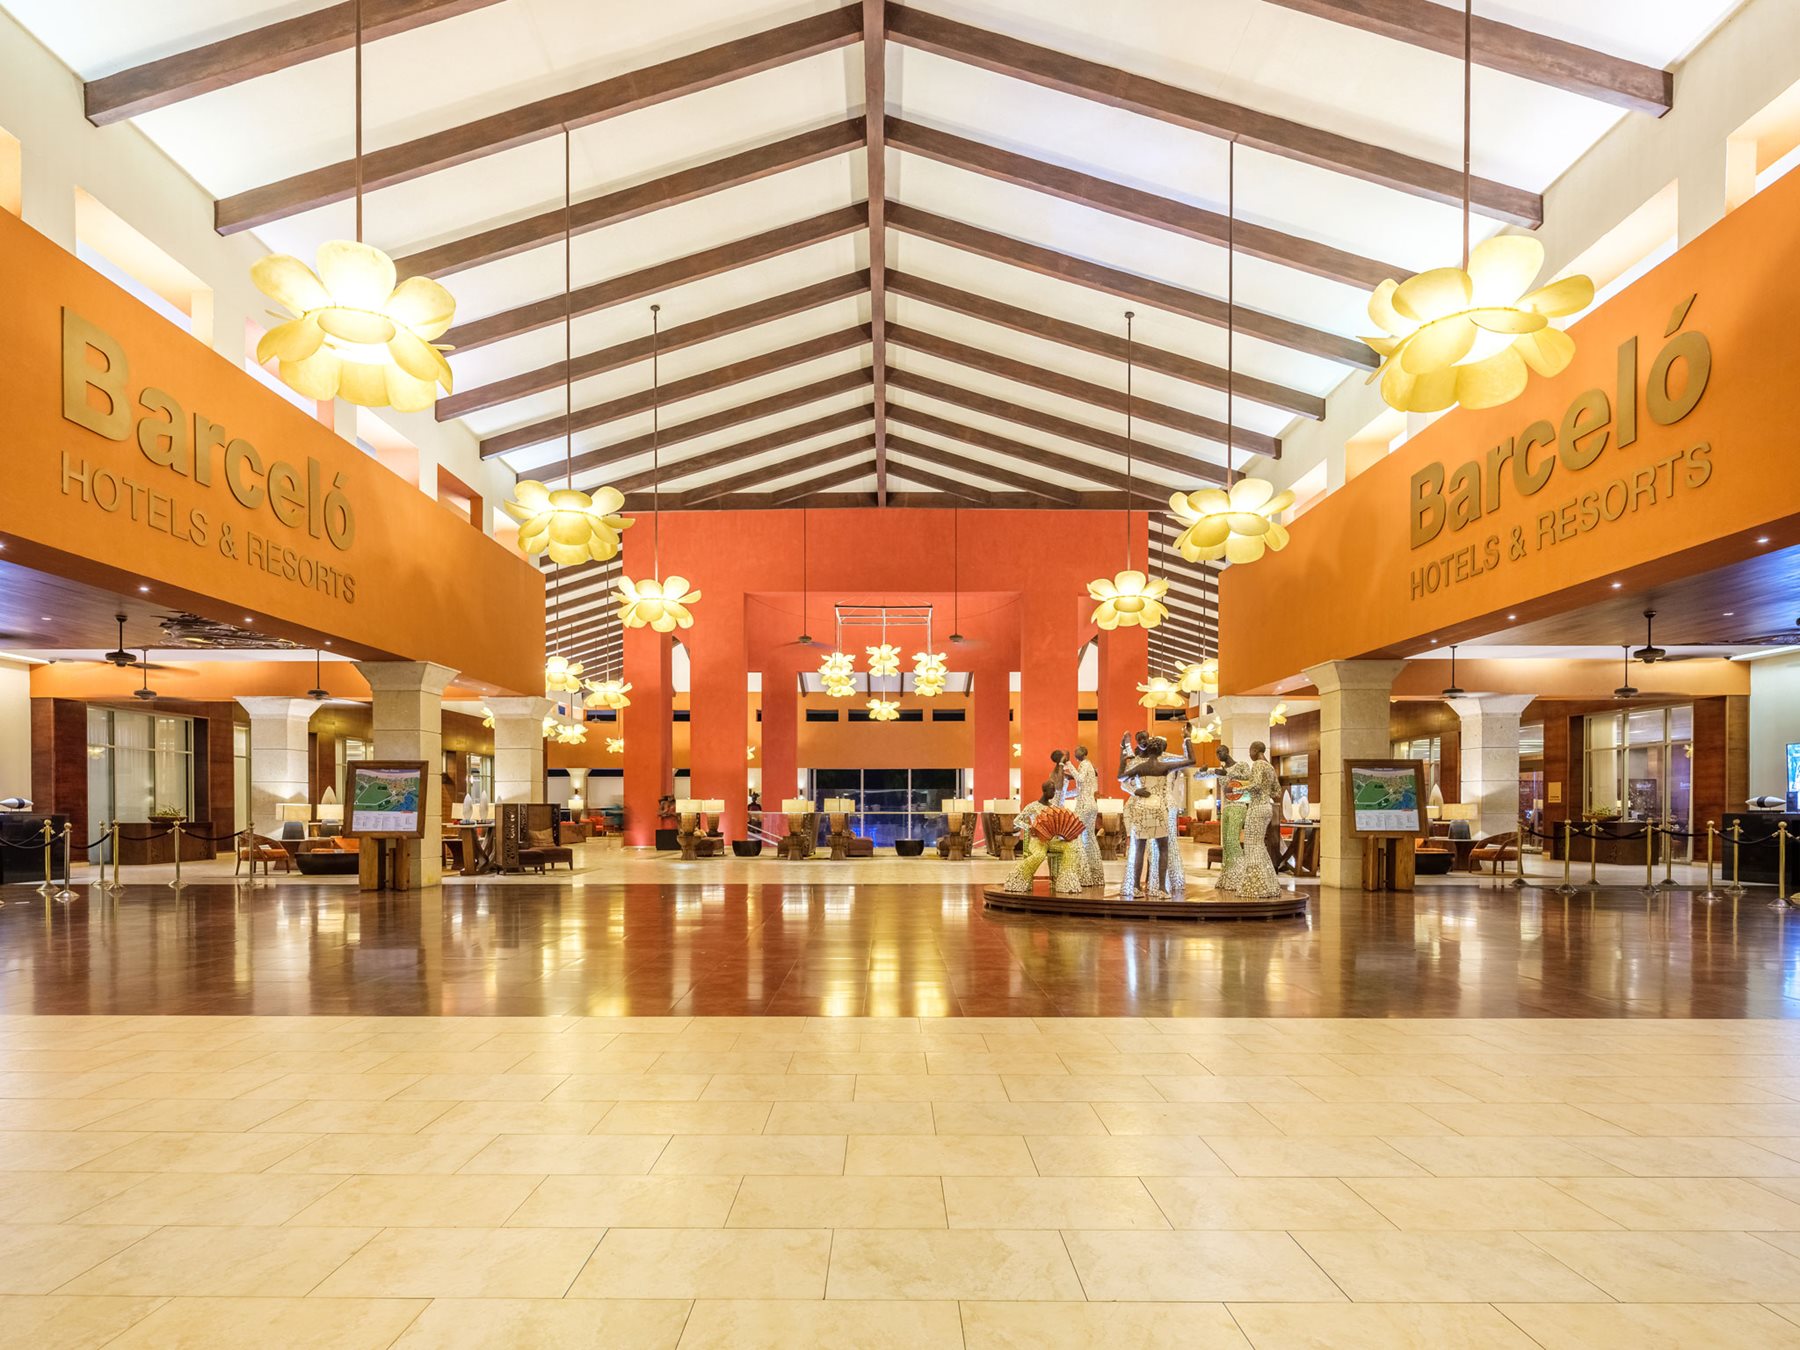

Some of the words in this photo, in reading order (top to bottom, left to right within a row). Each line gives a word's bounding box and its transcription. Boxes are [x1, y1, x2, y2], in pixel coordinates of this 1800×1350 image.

[61, 305, 356, 551] Barceló
[1410, 293, 1712, 550] Barceló
[1410, 535, 1500, 601] HOTELS
[1508, 525, 1527, 562] &
[1536, 442, 1712, 551] RESORTS
[61, 450, 208, 547] HOTELS
[218, 522, 239, 561] &
[247, 531, 356, 604] RESORTS
